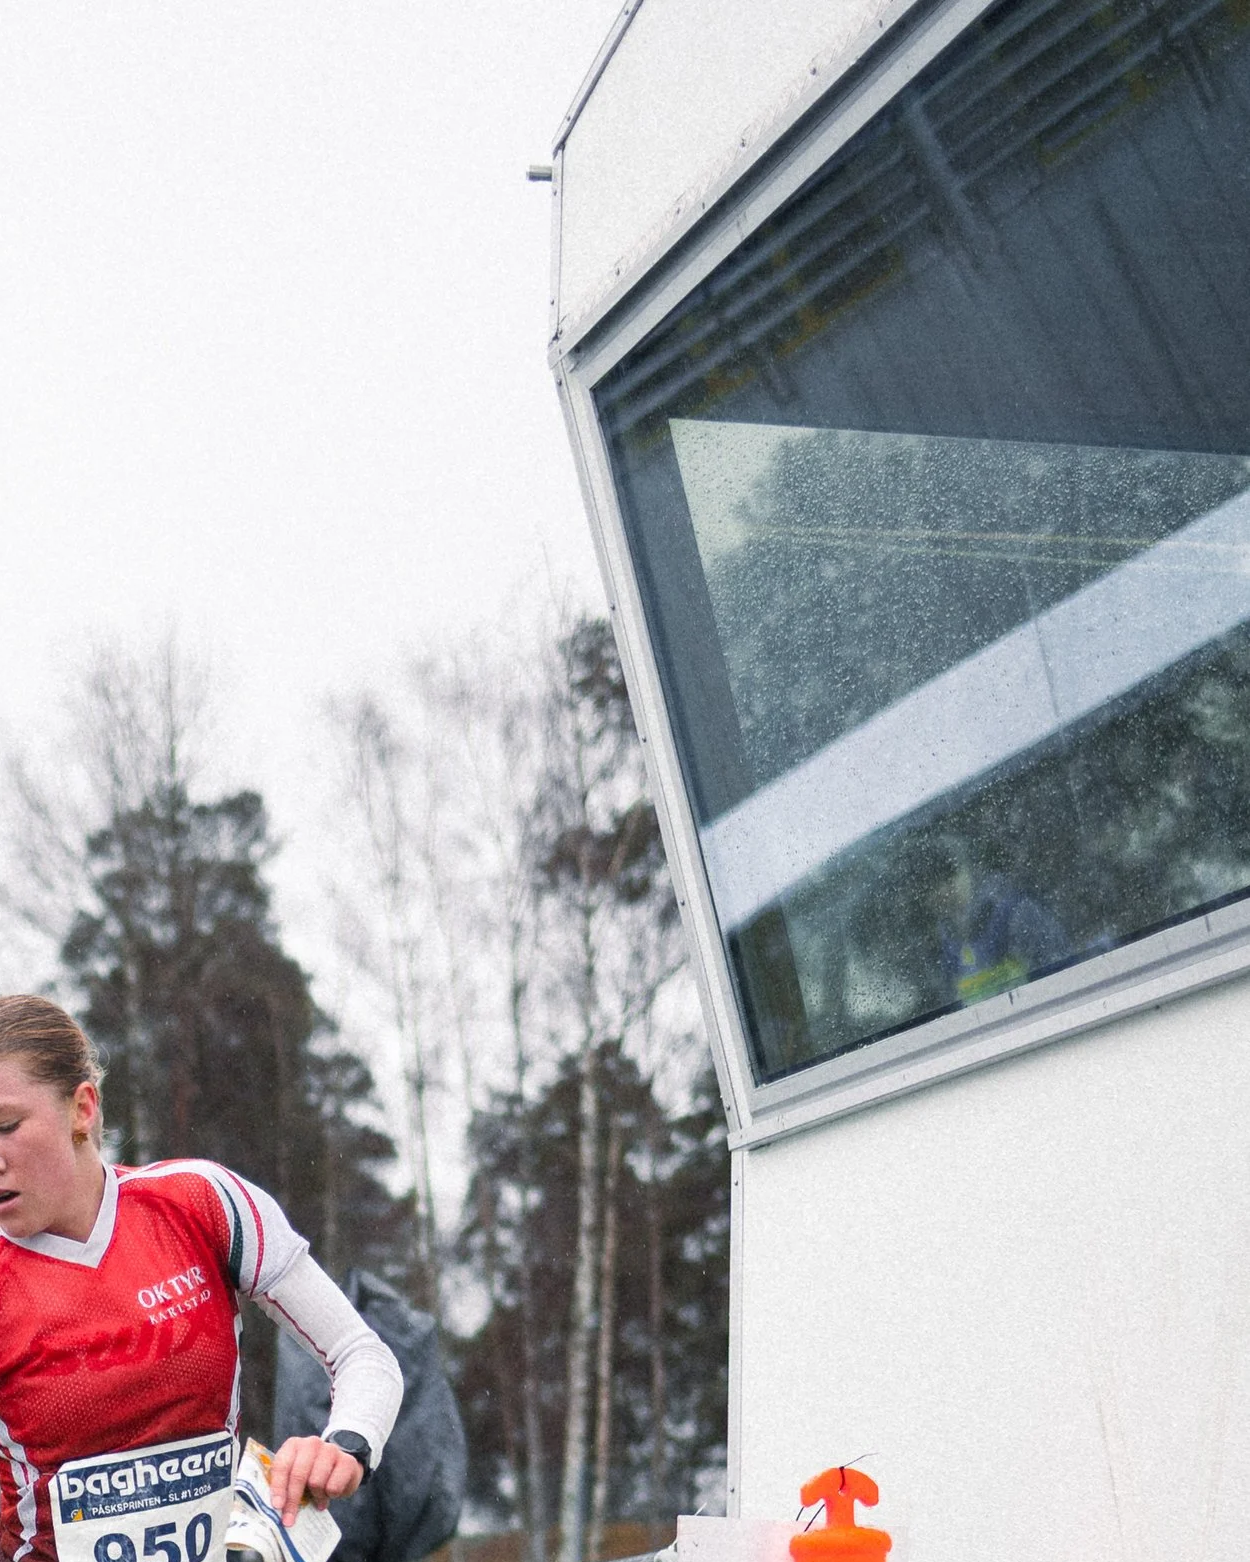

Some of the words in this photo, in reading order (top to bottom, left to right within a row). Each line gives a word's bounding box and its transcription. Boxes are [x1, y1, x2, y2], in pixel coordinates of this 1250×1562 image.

[137, 1281, 173, 1309] OK
[166, 1265, 207, 1297] TYR
[149, 1288, 212, 1326] KARLSTAD
[59, 1443, 233, 1501] bagheera
[91, 1495, 162, 1517] PÅSKSPRINTEN
[168, 1491, 180, 1503] SL
[180, 1488, 192, 1500] #1
[193, 1483, 212, 1497] 2026
